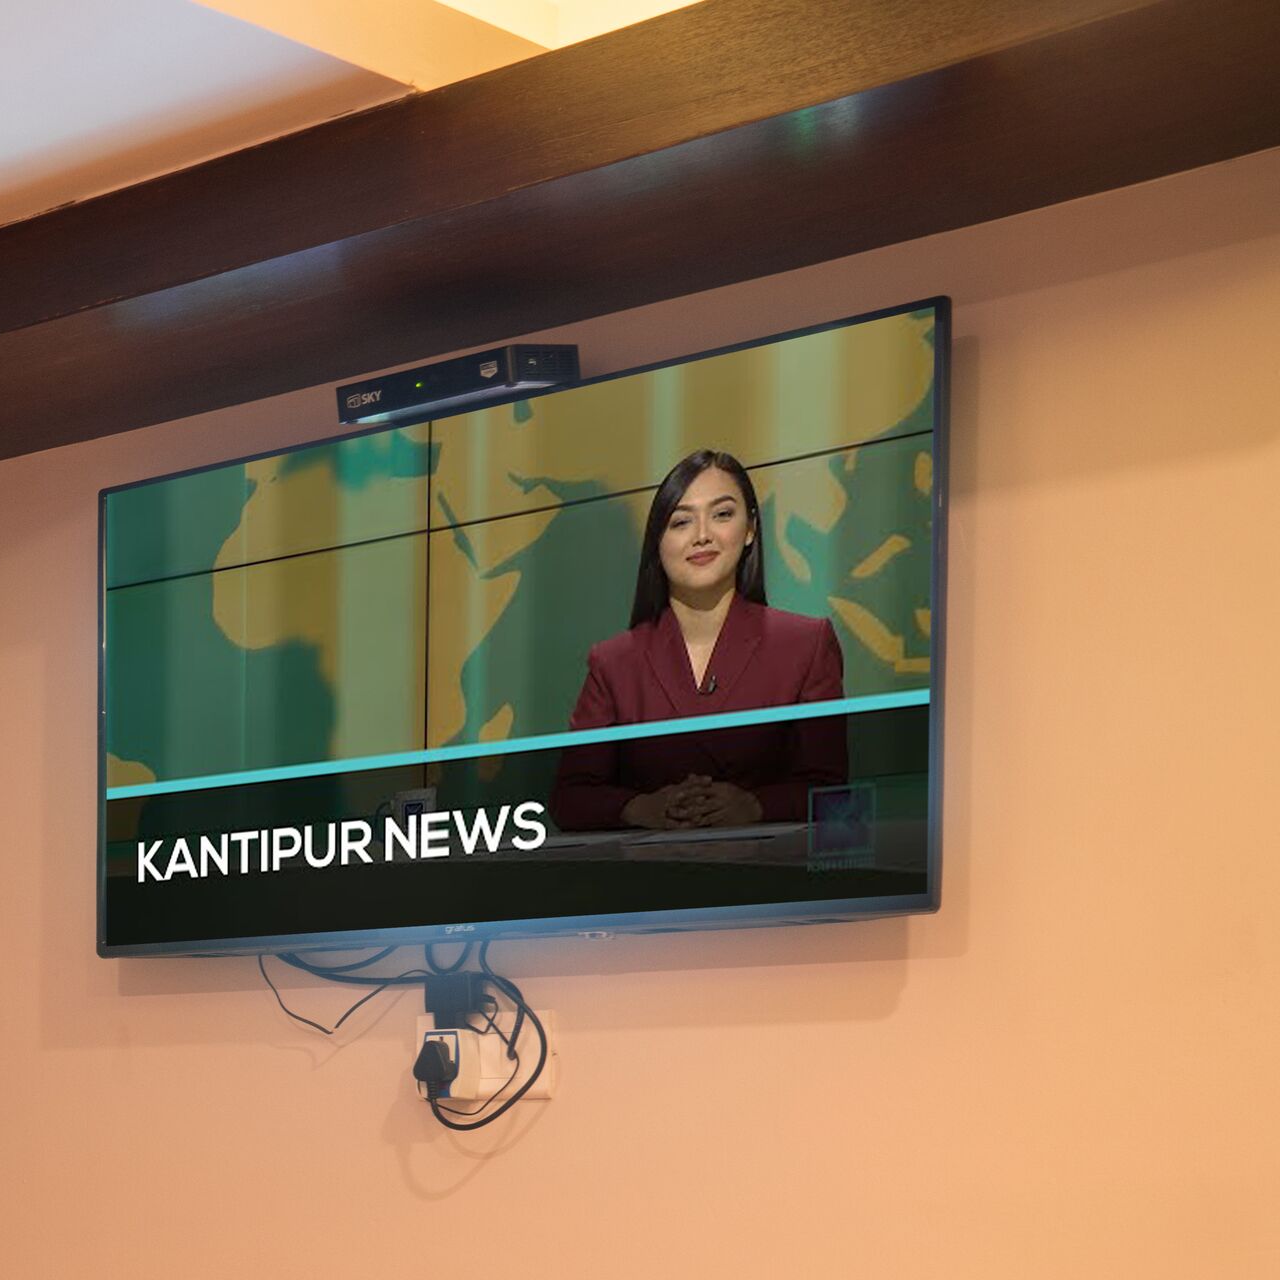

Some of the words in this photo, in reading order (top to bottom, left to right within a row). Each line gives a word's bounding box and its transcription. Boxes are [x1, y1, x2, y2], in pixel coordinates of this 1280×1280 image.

[361, 390, 382, 405] SKY
[137, 818, 373, 883] KANTIPUR
[384, 801, 547, 863] NEWS
